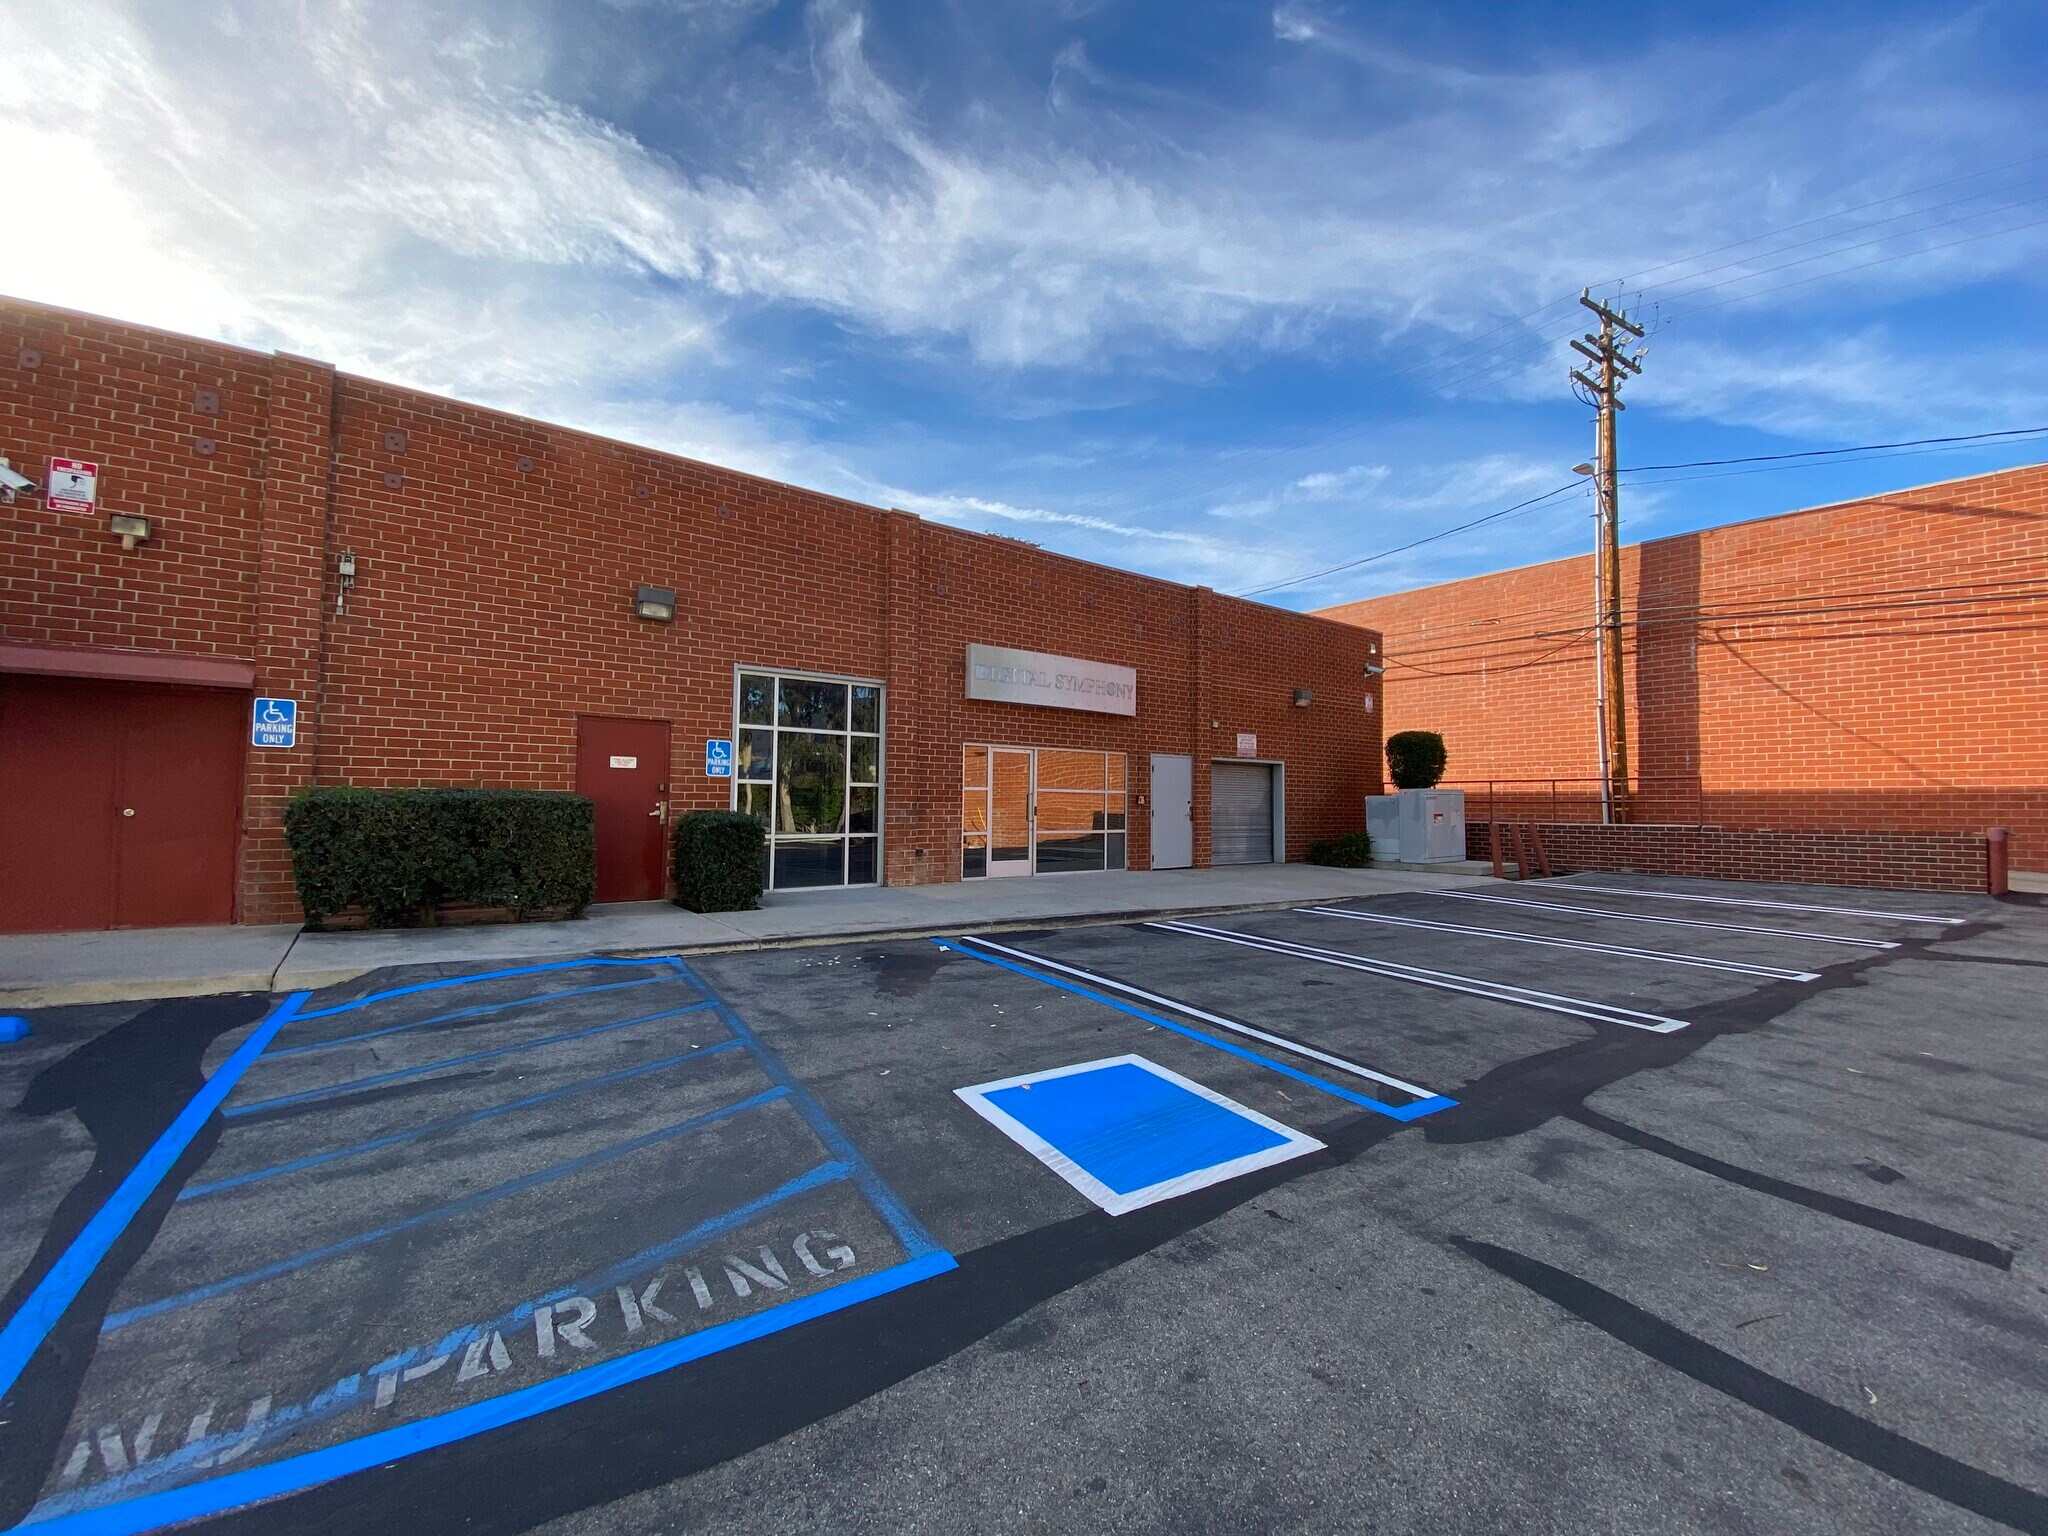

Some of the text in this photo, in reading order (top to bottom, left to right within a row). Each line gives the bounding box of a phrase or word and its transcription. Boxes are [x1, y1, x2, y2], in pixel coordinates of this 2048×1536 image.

[975, 663, 1134, 700] DIGITAL SYMPHONY
[256, 722, 293, 733] PARKING
[262, 733, 285, 743] ONLY
[707, 758, 730, 767] PARKING
[711, 766, 726, 775] ONLY
[367, 1229, 857, 1409] PARKING
